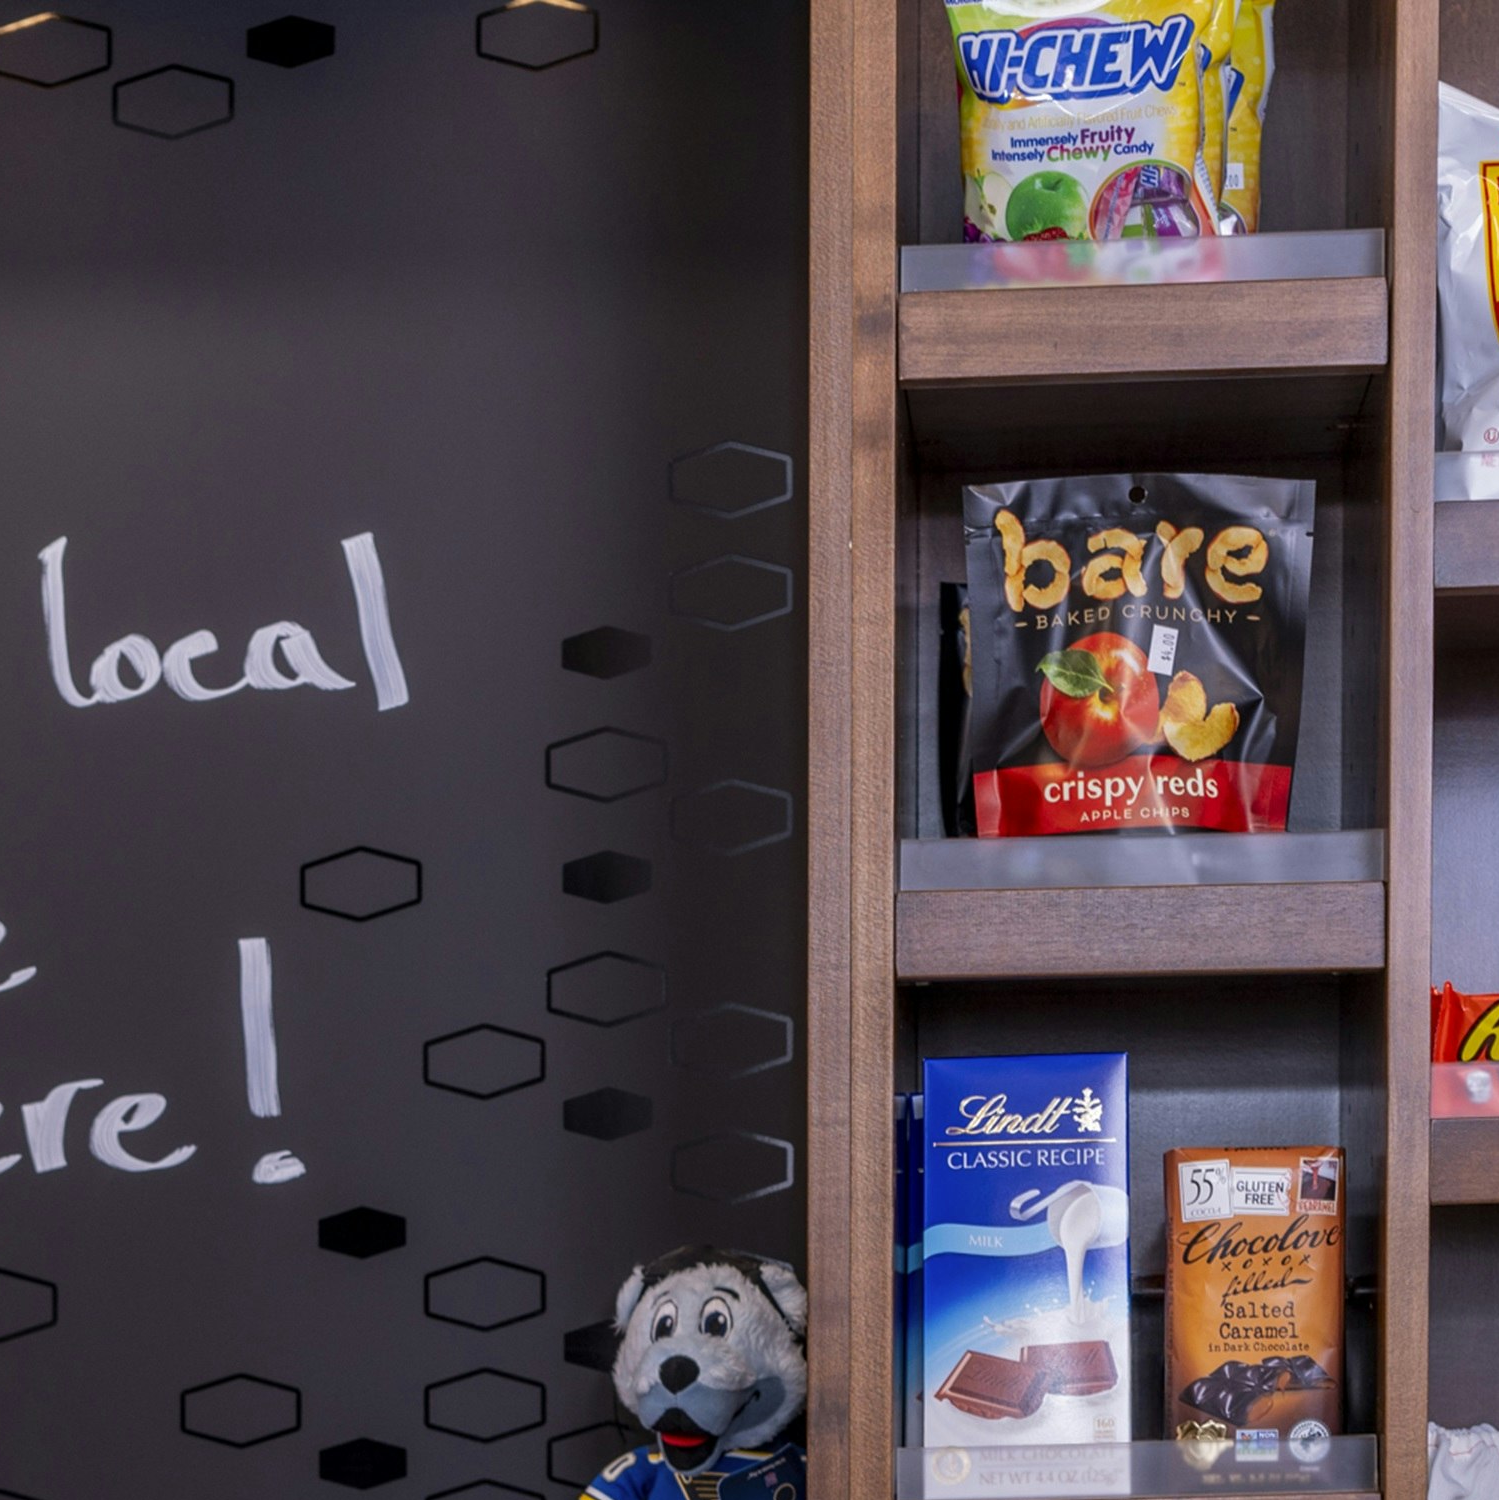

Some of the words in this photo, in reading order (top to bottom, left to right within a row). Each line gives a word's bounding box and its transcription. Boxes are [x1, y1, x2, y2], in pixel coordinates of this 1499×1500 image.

[1010, 132, 1079, 149] Immensely
[1080, 125, 1135, 144] Fruity
[991, 149, 1045, 162] Intensely
[1046, 143, 1112, 162] Chewy
[1113, 141, 1154, 156] Candy
[994, 509, 1269, 613] bare
[38, 532, 410, 711] local
[1036, 607, 1111, 630] BAKED
[1122, 605, 1238, 625] CRUNCHY
[1044, 771, 1145, 806] crispy
[1156, 768, 1219, 799] reds
[1080, 808, 1132, 823] APPLE
[1140, 806, 1190, 819] CHIPS
[946, 1094, 1072, 1136] Lindt
[947, 1150, 1031, 1170] CLASSIC
[1037, 1148, 1105, 1167] RECIPE
[1236, 1180, 1285, 1193] GLUTEN
[1245, 1193, 1275, 1205] FREE
[969, 1234, 1003, 1249] MILK
[1177, 1214, 1341, 1265] Chocolove
[1221, 1269, 1312, 1306] filled
[1224, 1301, 1294, 1319] Salted
[1219, 1323, 1299, 1340] Caramel
[1208, 1342, 1221, 1352] in
[1223, 1342, 1250, 1352] Dark
[1253, 1341, 1310, 1352] Chocolate
